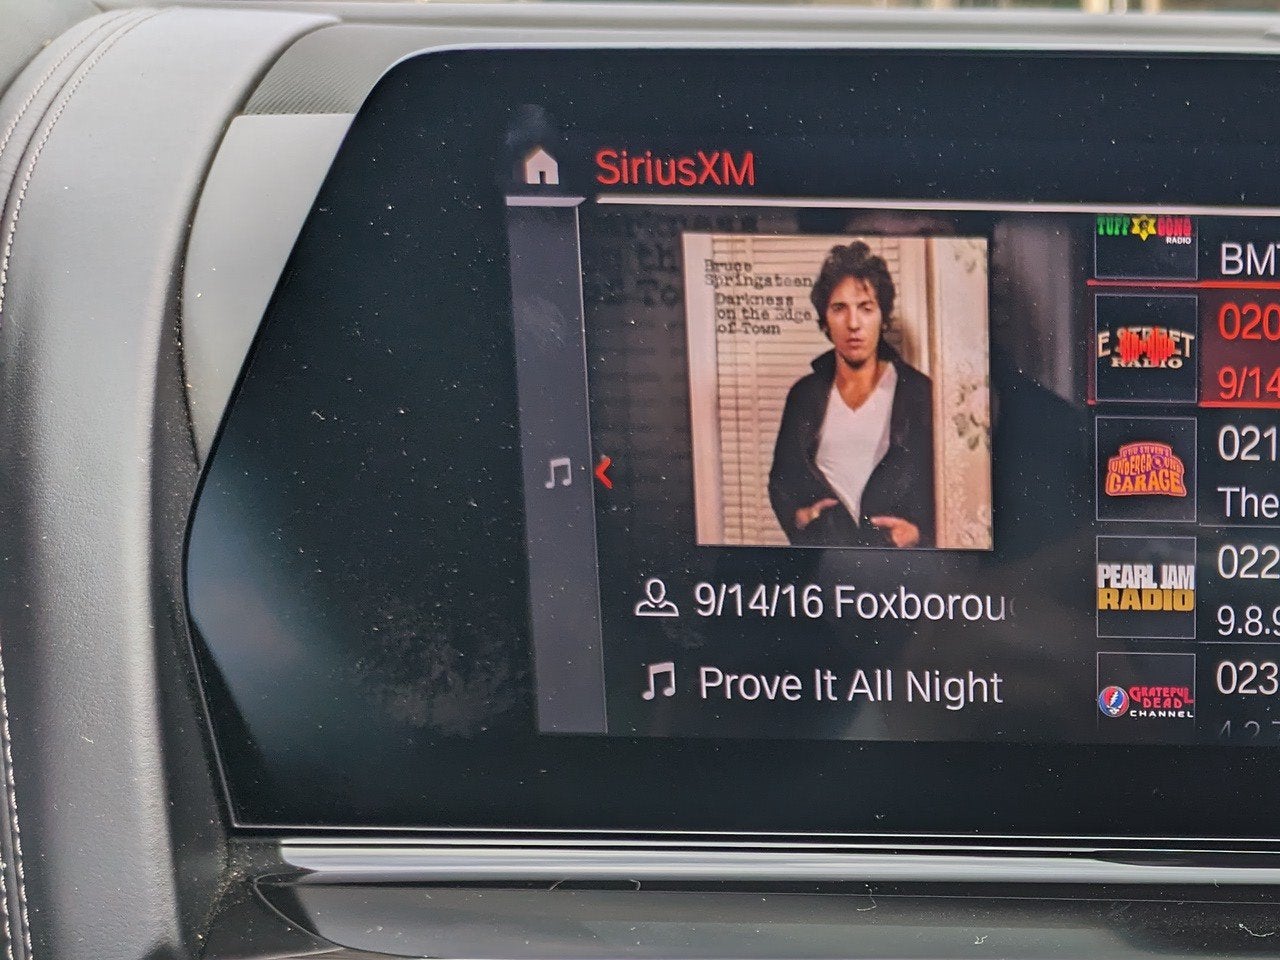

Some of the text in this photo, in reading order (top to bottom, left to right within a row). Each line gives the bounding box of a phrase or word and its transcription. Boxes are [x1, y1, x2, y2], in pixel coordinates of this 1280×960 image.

[595, 149, 755, 187] SiriusXM
[1166, 236, 1192, 245] RADIO
[704, 259, 752, 273] Bruce
[705, 273, 812, 289] Springsteen
[716, 292, 794, 306] Darkness
[717, 308, 736, 320] on
[741, 307, 770, 320] the
[718, 321, 781, 335] of Town
[1098, 330, 1111, 358] E
[1218, 425, 1277, 462] 021
[1109, 469, 1183, 494] GARAGE
[1217, 487, 1279, 518] The
[1218, 545, 1280, 580] 022
[1097, 563, 1195, 590] PEARL JAM
[694, 581, 1016, 622] 9/14/16 Foxborou
[1098, 588, 1195, 612] RADIO
[699, 666, 1004, 711] Prove It All Night
[1217, 662, 1279, 695] 023
[1128, 686, 1194, 704] GRATEFUL
[1143, 698, 1183, 709] DEAD
[1129, 710, 1194, 718] CHANNEL
